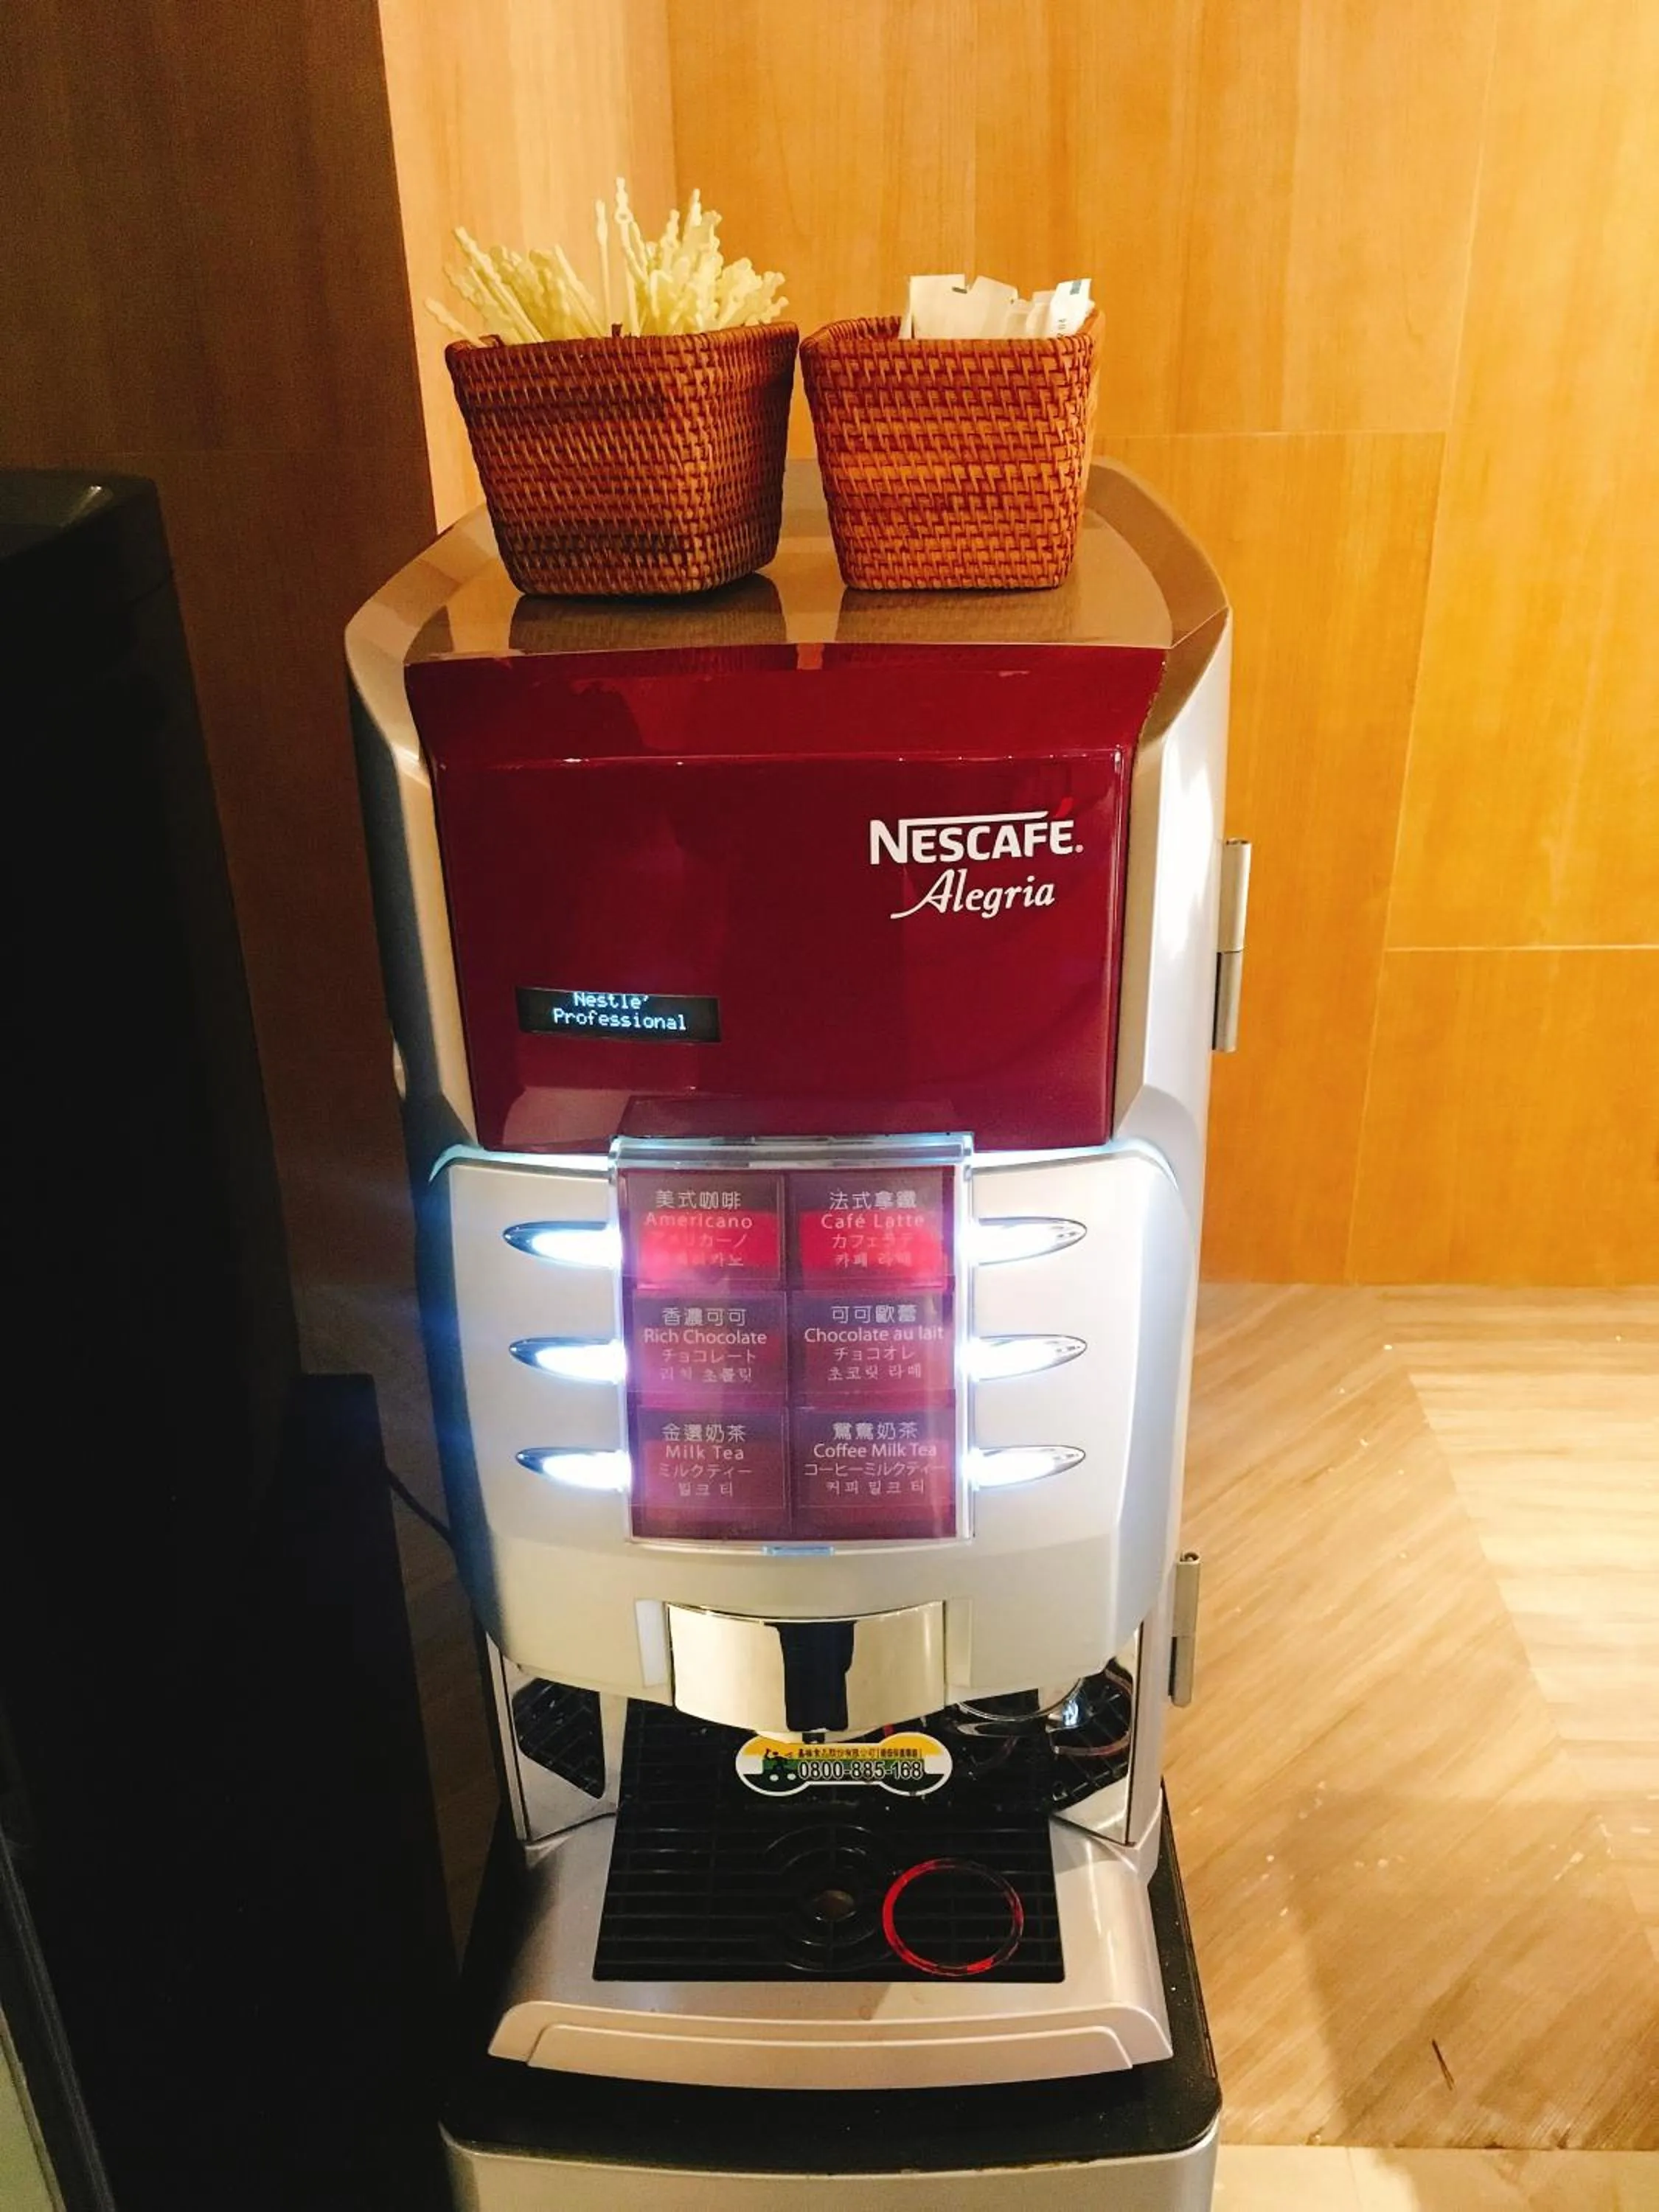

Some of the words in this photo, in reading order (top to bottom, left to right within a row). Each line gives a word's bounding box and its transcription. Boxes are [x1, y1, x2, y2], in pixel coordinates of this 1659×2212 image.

[890, 868, 1055, 919] Alegria
[553, 1008, 687, 1031] Professional
[655, 1189, 742, 1209] 美式咖啡
[830, 1191, 917, 1210] 法式拿鐵
[644, 1212, 753, 1229] Americano
[821, 1213, 866, 1229] Café
[874, 1213, 925, 1229] Latte
[832, 1233, 914, 1249] カフェラテ
[662, 1307, 747, 1326] 香濃可可
[831, 1304, 917, 1324] 可可歐蕾
[644, 1329, 678, 1344] Rich
[684, 1329, 768, 1345] Chocolate
[804, 1327, 888, 1343] Chocolate
[894, 1329, 914, 1340] au
[919, 1326, 945, 1340] lait
[662, 1349, 756, 1364] チョコレート
[832, 1346, 916, 1362] チョコオレ
[661, 1423, 746, 1443] 金選奶茶
[666, 1445, 705, 1460] Milk
[713, 1445, 745, 1460] Tea
[814, 1443, 867, 1458] Coffee
[872, 1443, 906, 1458] Milk
[908, 1443, 937, 1458] Tea
[658, 1463, 753, 1478] ミルクティー
[804, 1461, 946, 1477] コーヒーミルクティー
[720, 1481, 733, 1497] 티
[826, 1480, 859, 1495] 커피
[911, 1479, 924, 1495] 티
[798, 1761, 922, 1781] 0800-885-168
